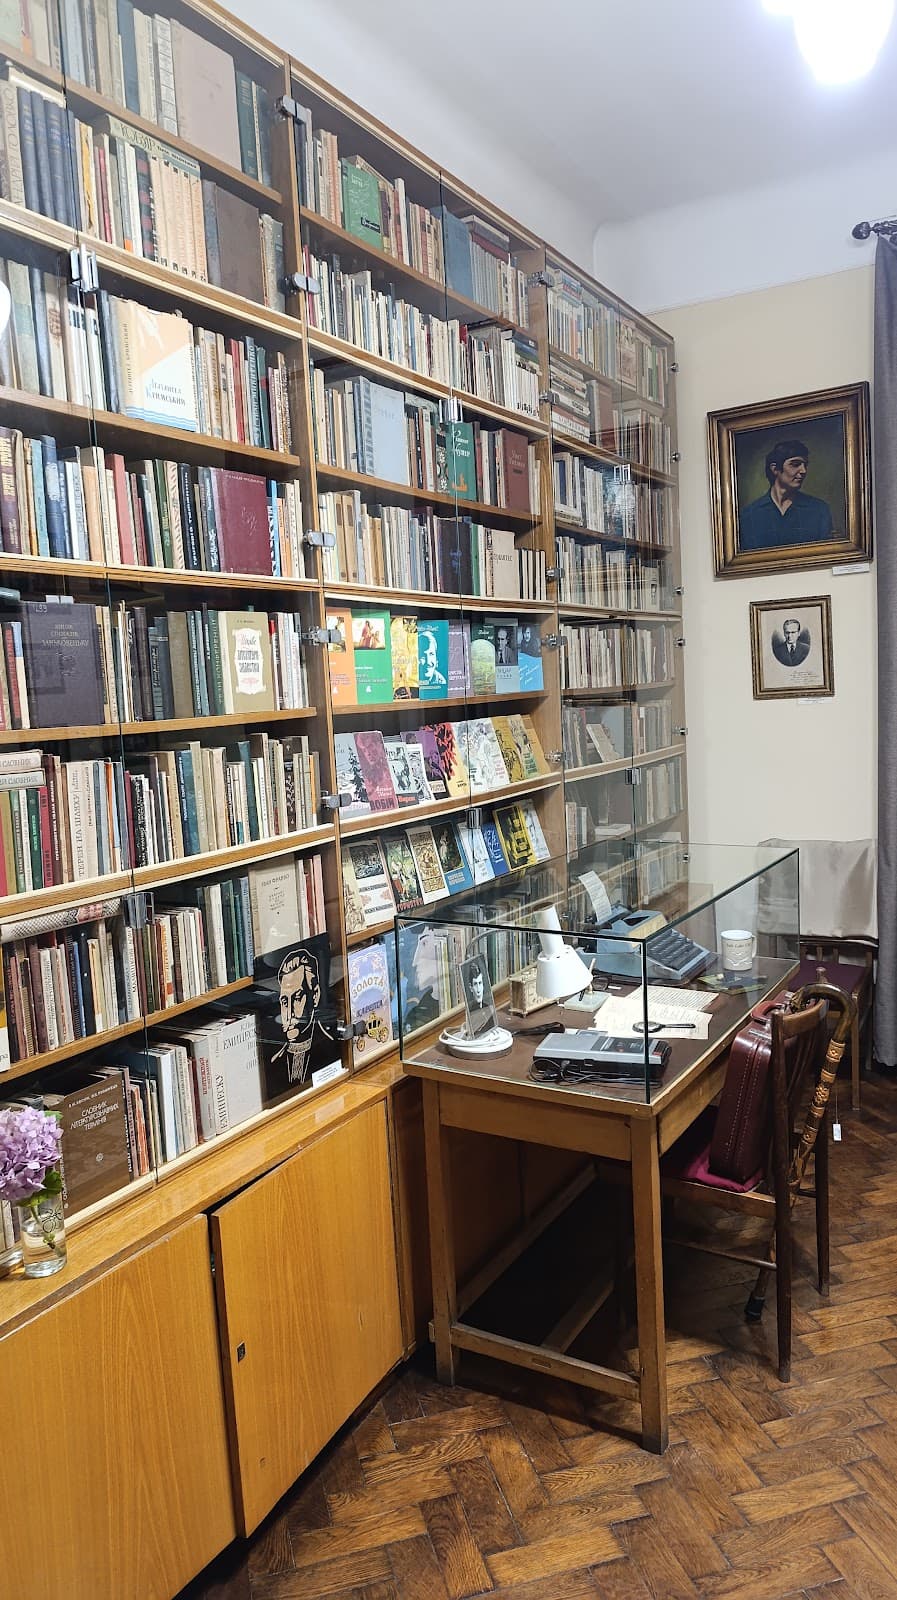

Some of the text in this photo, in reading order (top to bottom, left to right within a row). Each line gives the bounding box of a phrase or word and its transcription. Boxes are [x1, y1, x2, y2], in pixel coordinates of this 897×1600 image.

[73, 794, 85, 877] ТЕРЕН НА ШЛЯХУ
[351, 975, 384, 999] ЗОЛОТА
[81, 1100, 108, 1117] СЛОВНИК
[84, 1115, 107, 1131] ТЕРМІНІВ
